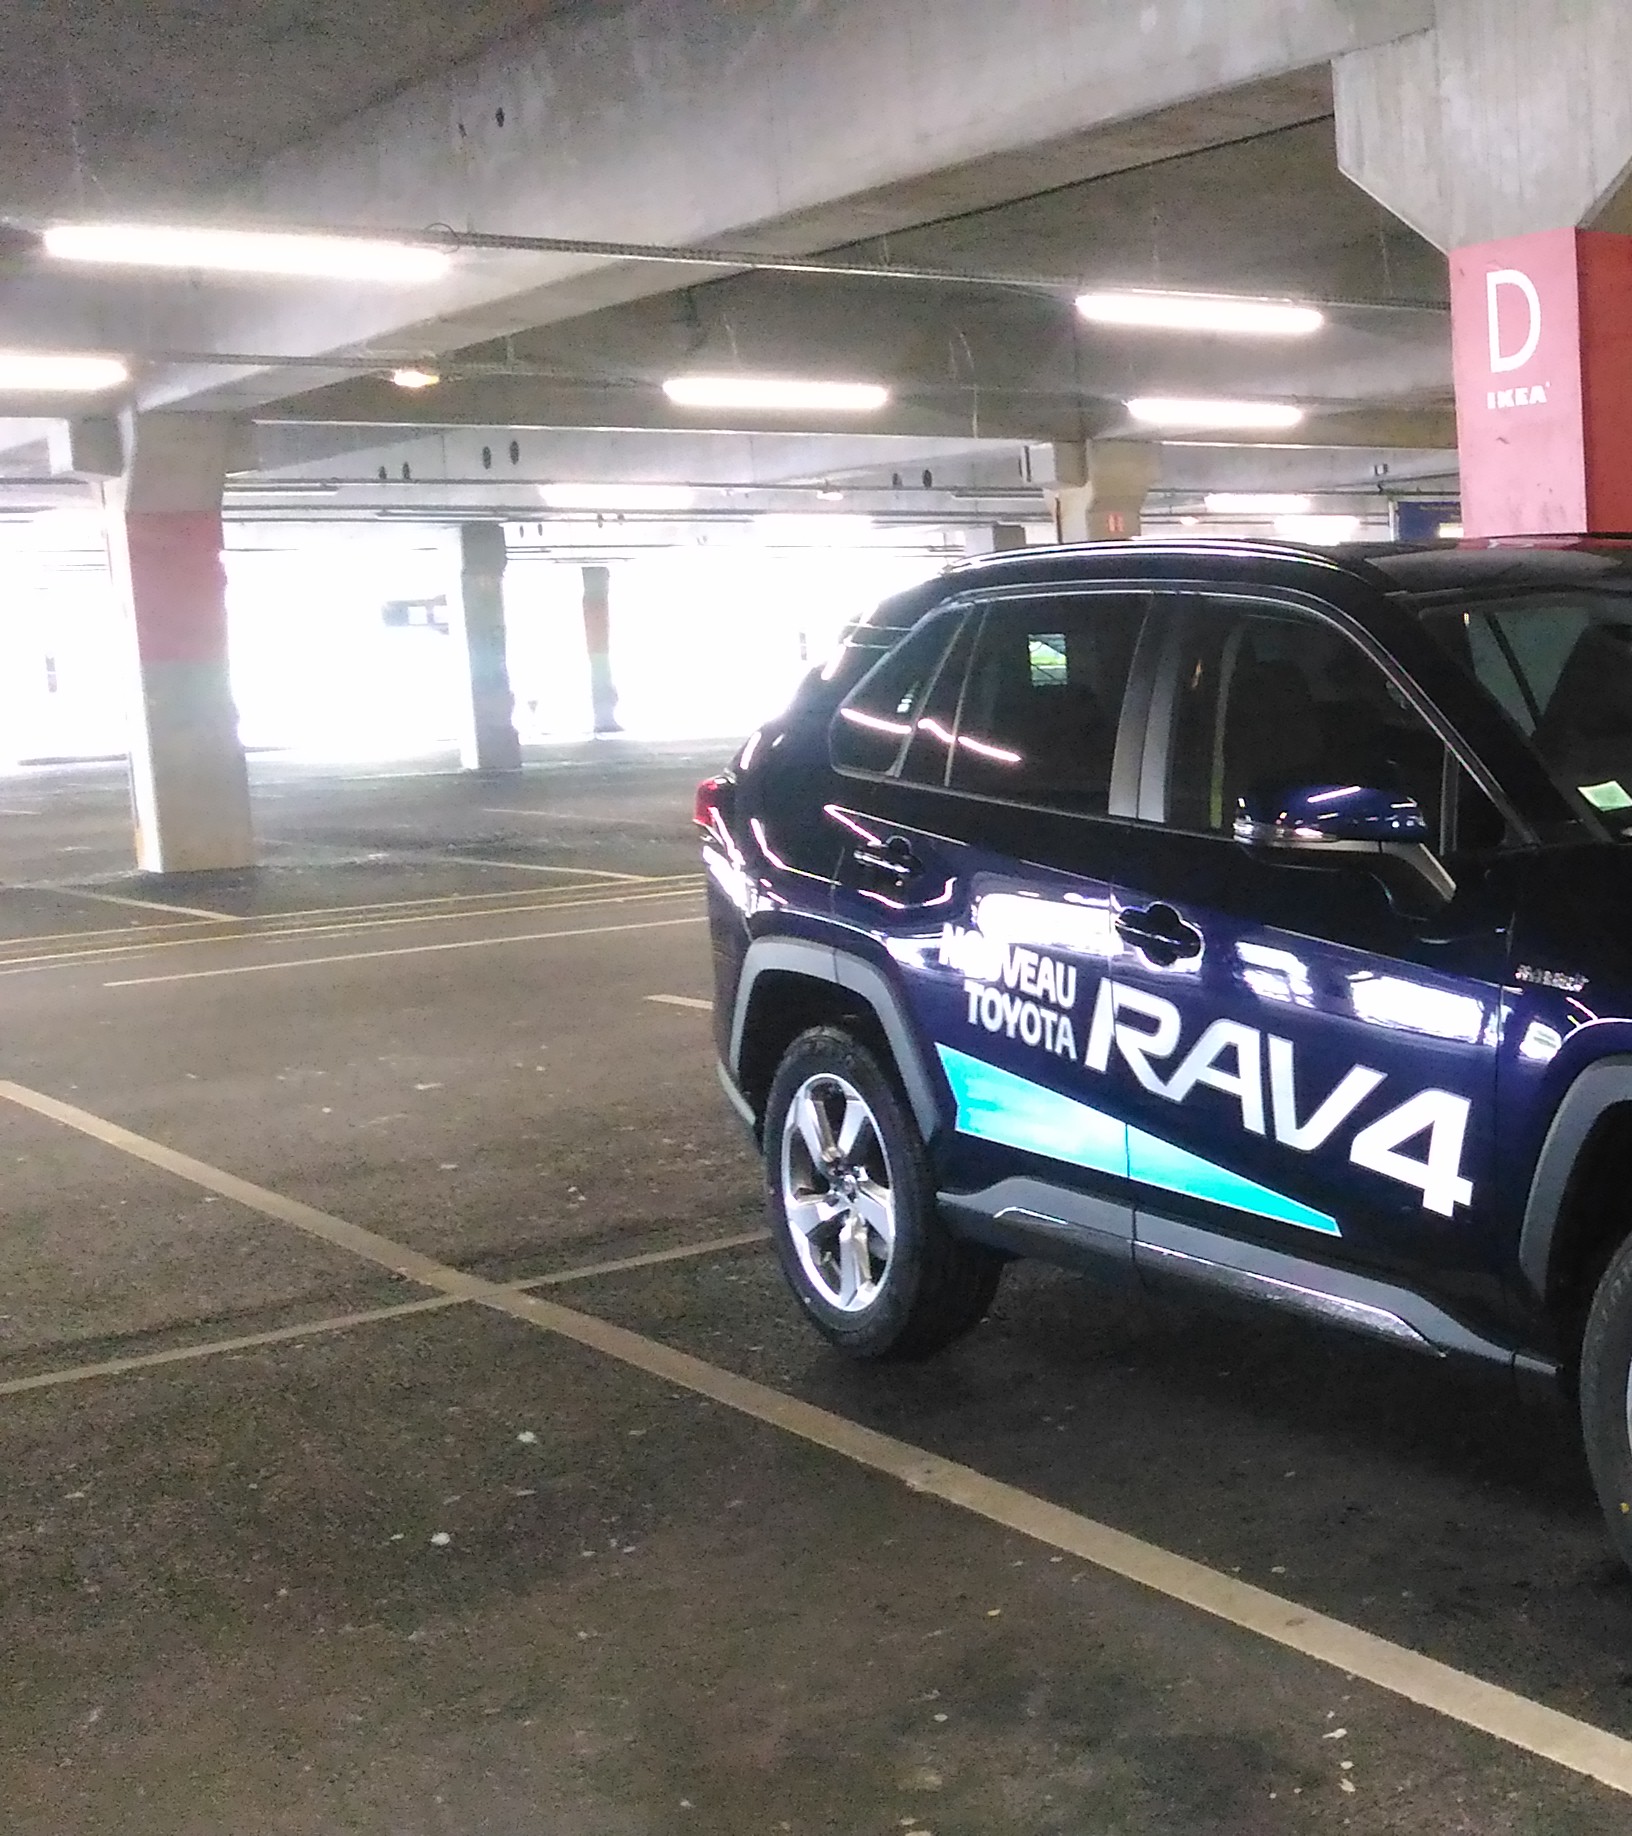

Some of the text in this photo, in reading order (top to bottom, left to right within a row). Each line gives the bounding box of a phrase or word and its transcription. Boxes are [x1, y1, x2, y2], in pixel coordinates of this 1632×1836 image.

[1486, 269, 1541, 373] D
[1487, 385, 1547, 409] IKEA
[939, 922, 1077, 1010] NOVEAU
[964, 978, 1078, 1060] TOYOTA
[1084, 977, 1474, 1218] RAV4
